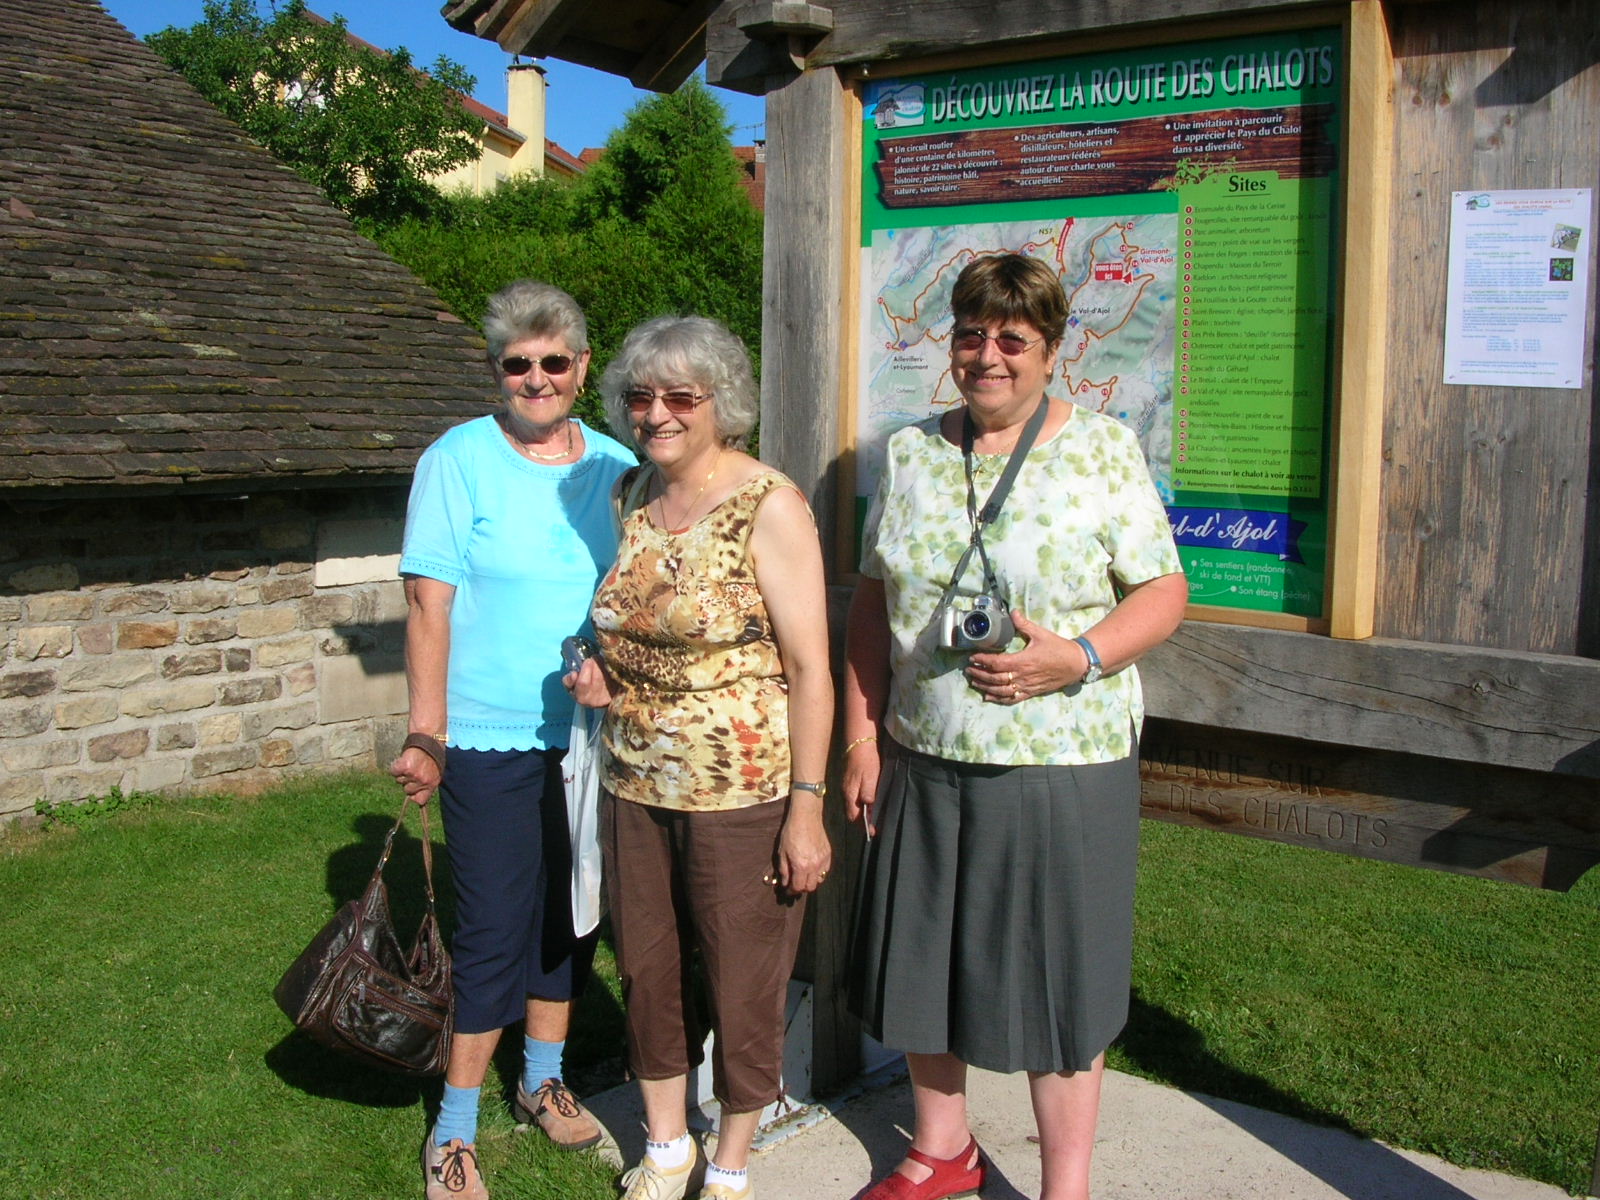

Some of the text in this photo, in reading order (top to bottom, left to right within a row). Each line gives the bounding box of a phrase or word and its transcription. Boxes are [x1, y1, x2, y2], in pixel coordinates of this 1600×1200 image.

[932, 46, 1332, 120] DÉCOUVREZ LA ROUTE DES CHALOTS
[1173, 122, 1191, 130] Une
[1193, 118, 1233, 129] invitation
[1241, 113, 1283, 127] parcourir
[1021, 127, 1119, 142] Des agriculteurs, artisans,
[1172, 134, 1181, 142] et
[1184, 130, 1225, 144] apprécier
[1227, 129, 1236, 138] le
[1237, 128, 1257, 140] Pays
[1258, 127, 1271, 136] du
[894, 141, 953, 154] Un circuit routier
[1021, 138, 1113, 153] distillateurs, hôteliers et
[1172, 141, 1245, 154] dans sa diversité.
[894, 149, 996, 164] d'une centaine de kilomètres
[1020, 150, 1101, 164] restaurateurs fédérés
[894, 165, 920, 176] jalonné
[921, 163, 930, 172] de
[931, 163, 940, 171] 22
[941, 162, 957, 170] sites
[964, 158, 999, 168] découvrir
[1020, 161, 1116, 175] autour d'une charte vous
[894, 170, 980, 185] histoire, patrimoine bâti,
[1020, 176, 1064, 186] accueillent.
[1228, 175, 1267, 193] Sites
[894, 184, 961, 196] nature, savoir-faire.
[1236, 203, 1249, 213] Pays
[1240, 225, 1271, 234] arboretum
[1223, 238, 1240, 247] point
[1140, 255, 1174, 265] Val-d'Ajol
[1217, 249, 1227, 258] des
[1252, 249, 1282, 257] extraction
[1222, 272, 1259, 280] architecture
[1079, 306, 1110, 316] Val-d'Ajol
[1245, 411, 1262, 421] point
[1272, 412, 1284, 420] vue
[1175, 467, 1219, 477] Informations
[1221, 470, 1232, 478] sur
[1233, 468, 1240, 477] le
[1241, 469, 1263, 479] chalot
[1270, 471, 1285, 480] voir
[1170, 512, 1279, 549] l-d'Ajol
[1200, 558, 1213, 568] Ses
[1215, 561, 1245, 571] sentiers
[1199, 569, 1271, 586] ski de fond et VTT)
[1238, 585, 1254, 595] Son
[1255, 587, 1279, 600] étang
[1139, 742, 1323, 799] NVENUE SUR
[1169, 782, 1224, 817] DES
[1243, 796, 1388, 849] CHALOTS
